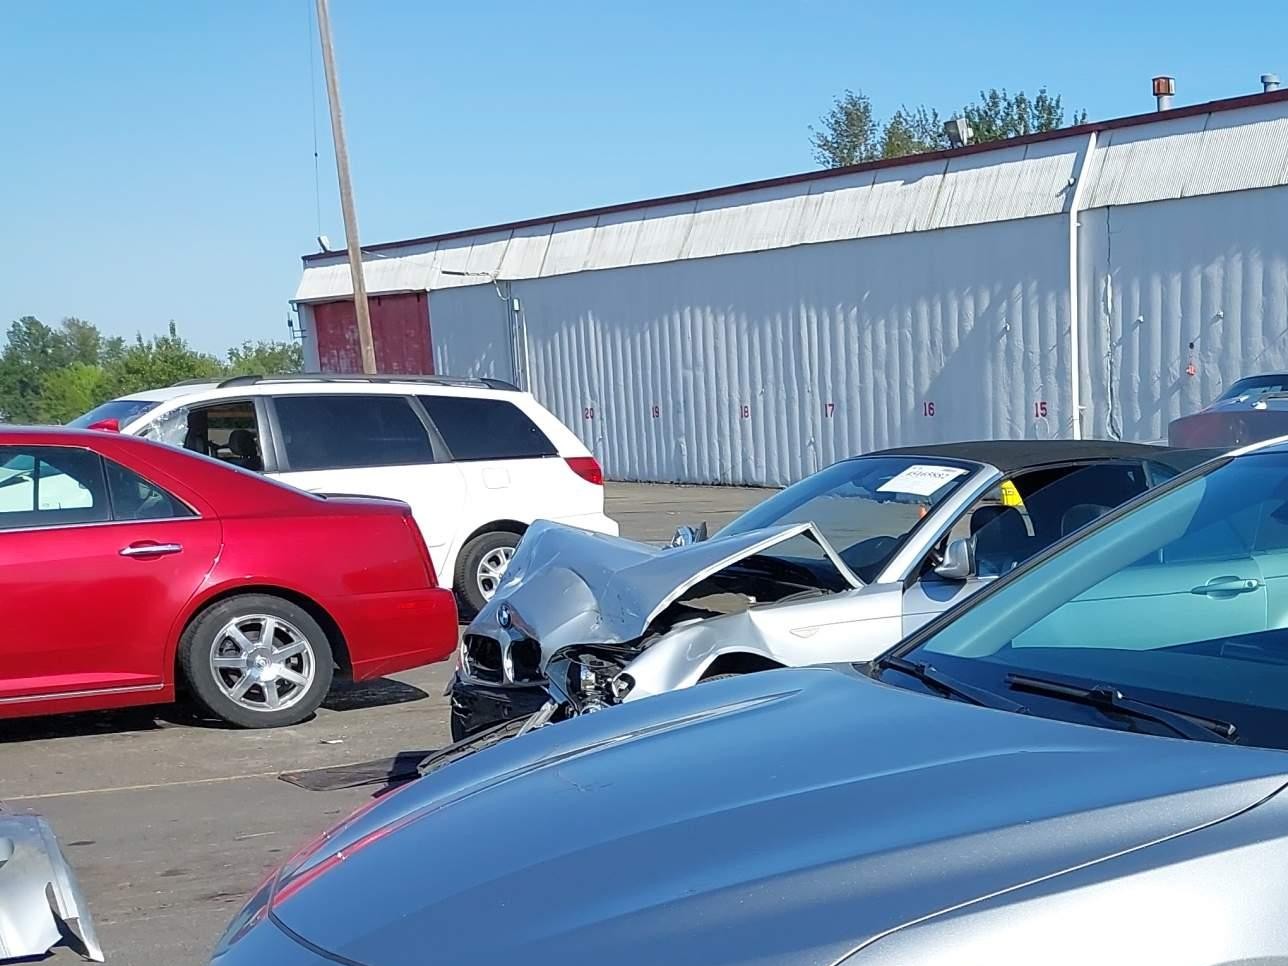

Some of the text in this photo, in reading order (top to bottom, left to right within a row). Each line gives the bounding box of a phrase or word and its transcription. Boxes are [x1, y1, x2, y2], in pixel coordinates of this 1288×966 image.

[584, 407, 594, 420] 20
[651, 405, 660, 418] 19
[739, 405, 749, 418] 18
[824, 403, 834, 418] 17
[923, 402, 935, 417] 16
[1034, 401, 1048, 418] 15
